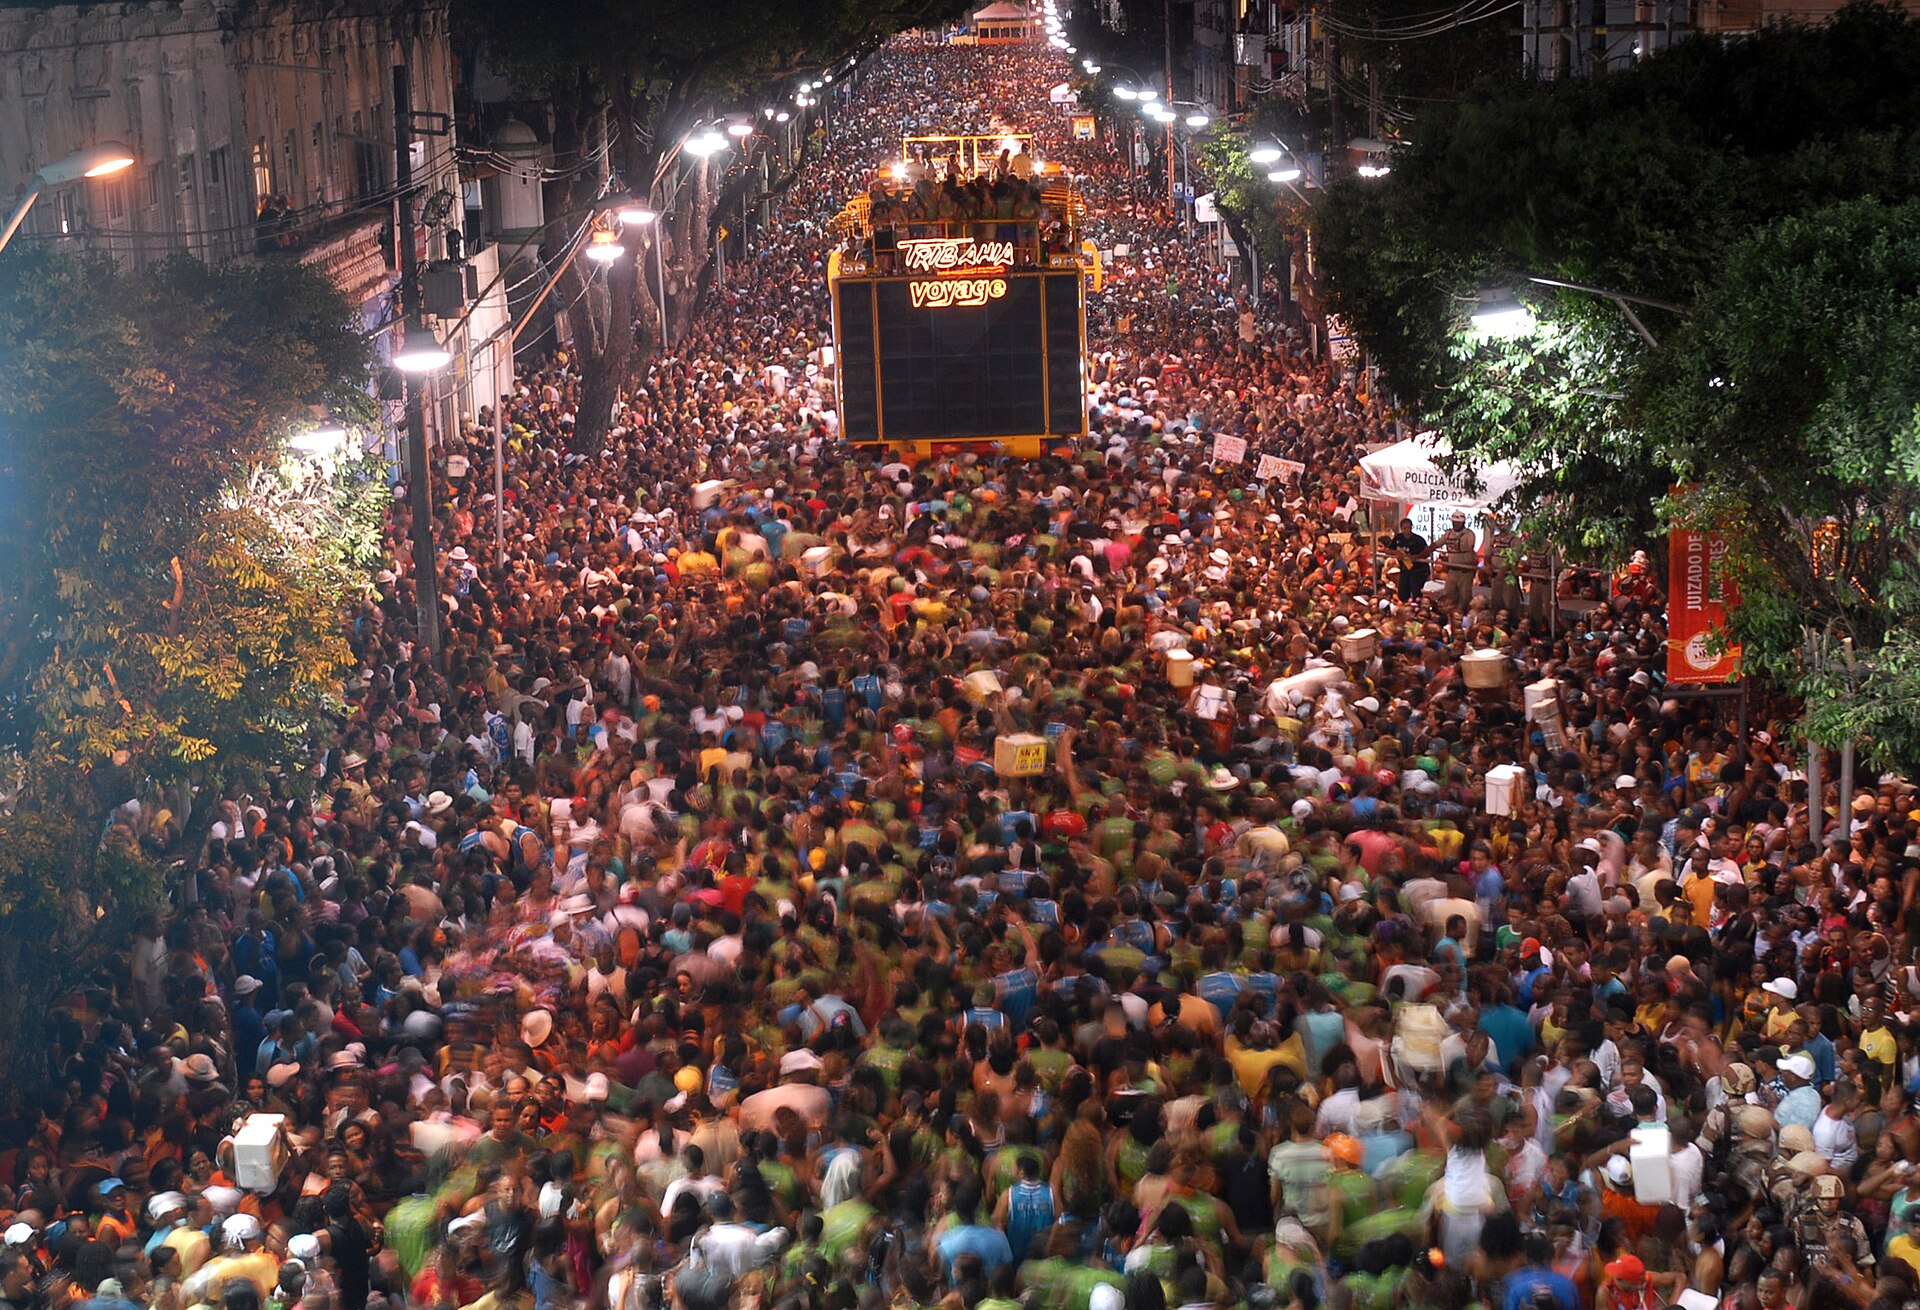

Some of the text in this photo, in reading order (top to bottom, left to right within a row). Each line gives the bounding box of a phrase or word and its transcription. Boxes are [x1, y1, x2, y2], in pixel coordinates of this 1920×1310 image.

[1405, 471, 1445, 487] POLÍCIA
[1687, 535, 1703, 611] JUIZADO DE
